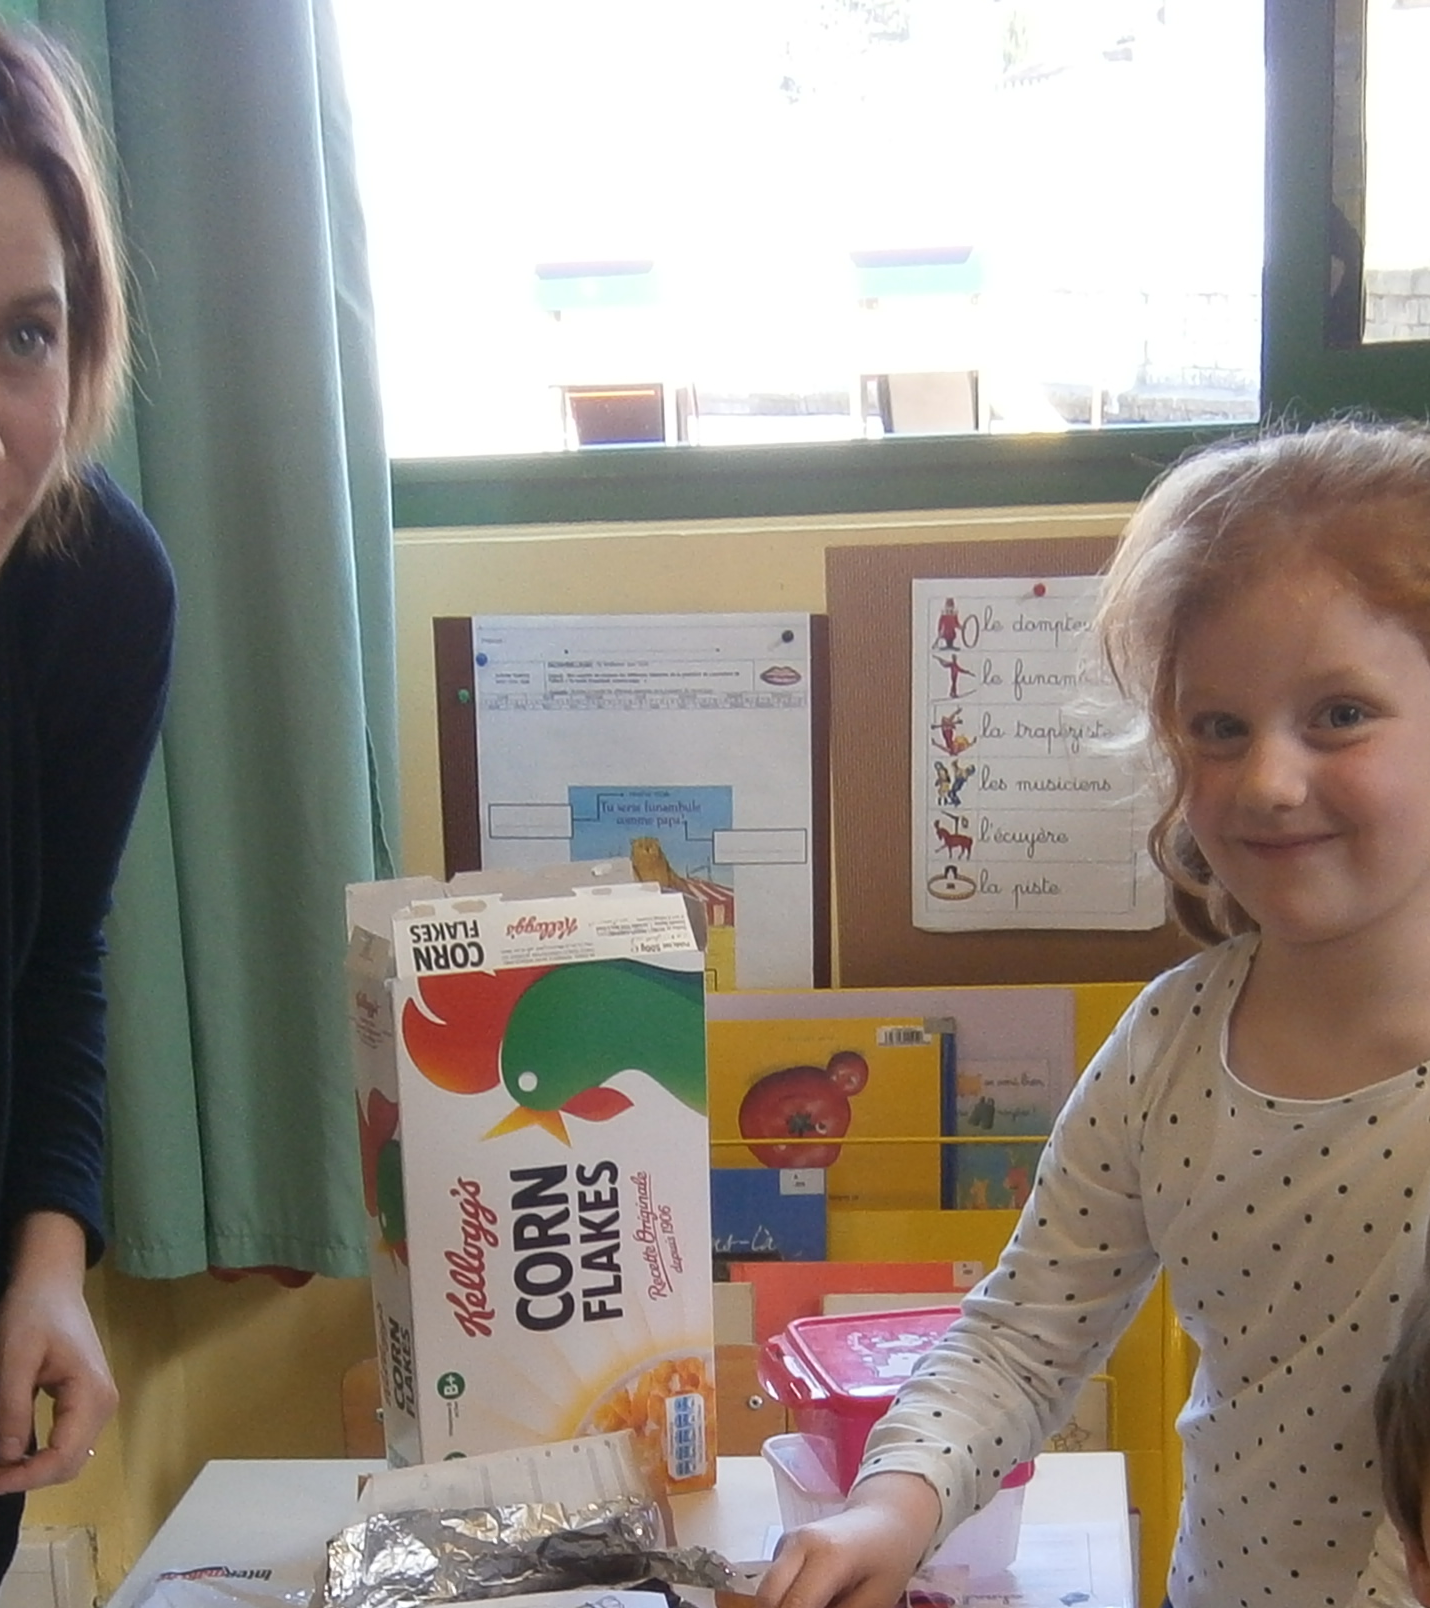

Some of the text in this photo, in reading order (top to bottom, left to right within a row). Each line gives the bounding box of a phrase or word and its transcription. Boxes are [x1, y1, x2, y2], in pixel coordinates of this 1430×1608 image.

[979, 605, 1004, 632] le
[979, 658, 1004, 686] le
[979, 711, 1006, 739] la
[979, 764, 1112, 793] les musiciens
[976, 868, 1061, 911] la piste
[409, 919, 480, 943] FLAKES
[505, 917, 578, 940] Kellogg's
[415, 942, 485, 972] CORN
[658, 1204, 674, 1236] 1906
[509, 1164, 575, 1332] CORN
[576, 1160, 624, 1323] FLAKES
[629, 1170, 669, 1301] Recette Originale
[444, 1176, 499, 1338] Kellogg's
[388, 1315, 407, 1411] CORN
[443, 1374, 460, 1396] B+
